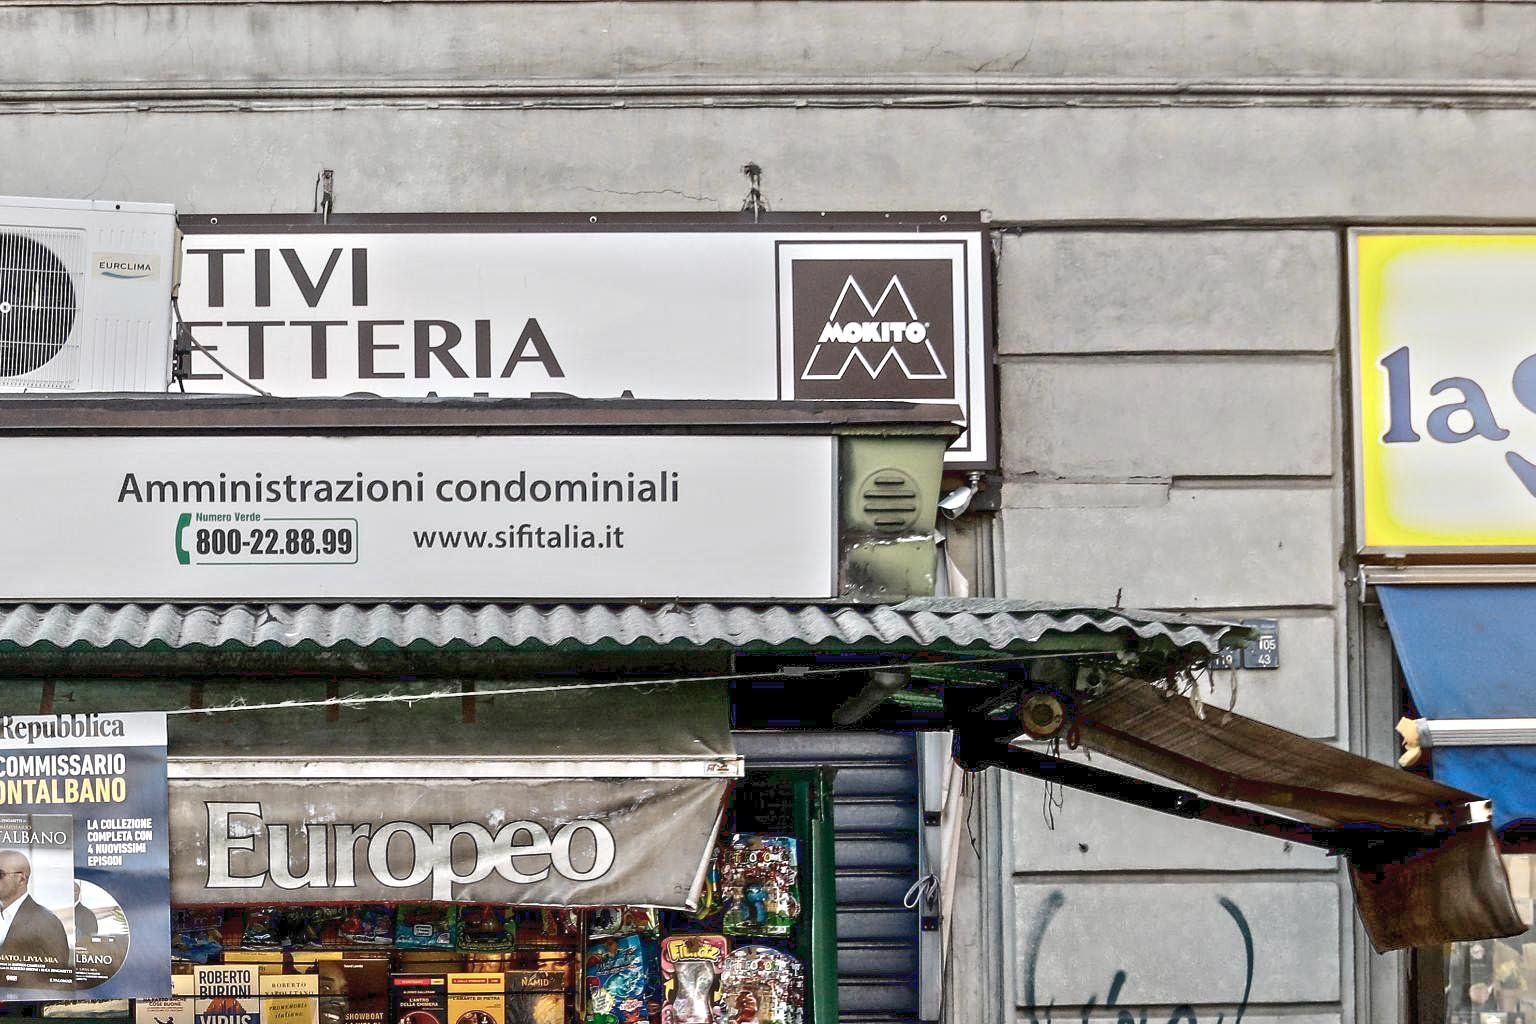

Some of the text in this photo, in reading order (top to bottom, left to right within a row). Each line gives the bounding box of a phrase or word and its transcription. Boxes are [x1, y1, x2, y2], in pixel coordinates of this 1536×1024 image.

[99, 261, 152, 272] EURCLIMA
[186, 247, 368, 308] TIVI
[818, 321, 928, 344] MOKITO
[117, 471, 680, 504] Amministrazioni condominiali
[196, 512, 261, 522] Numero Verde
[196, 528, 353, 556] 800-22.88.99
[412, 524, 625, 549] www.sifitalia.it
[87, 818, 153, 830] LA COLLEZIONE
[87, 830, 153, 842] COMPLETA CON
[87, 843, 146, 854] 4 NUOVISSIMI
[205, 800, 616, 902] Europeo
[87, 855, 123, 867] EPISODI
[199, 969, 251, 984] ROBERTO
[199, 985, 251, 999] BURIONI
